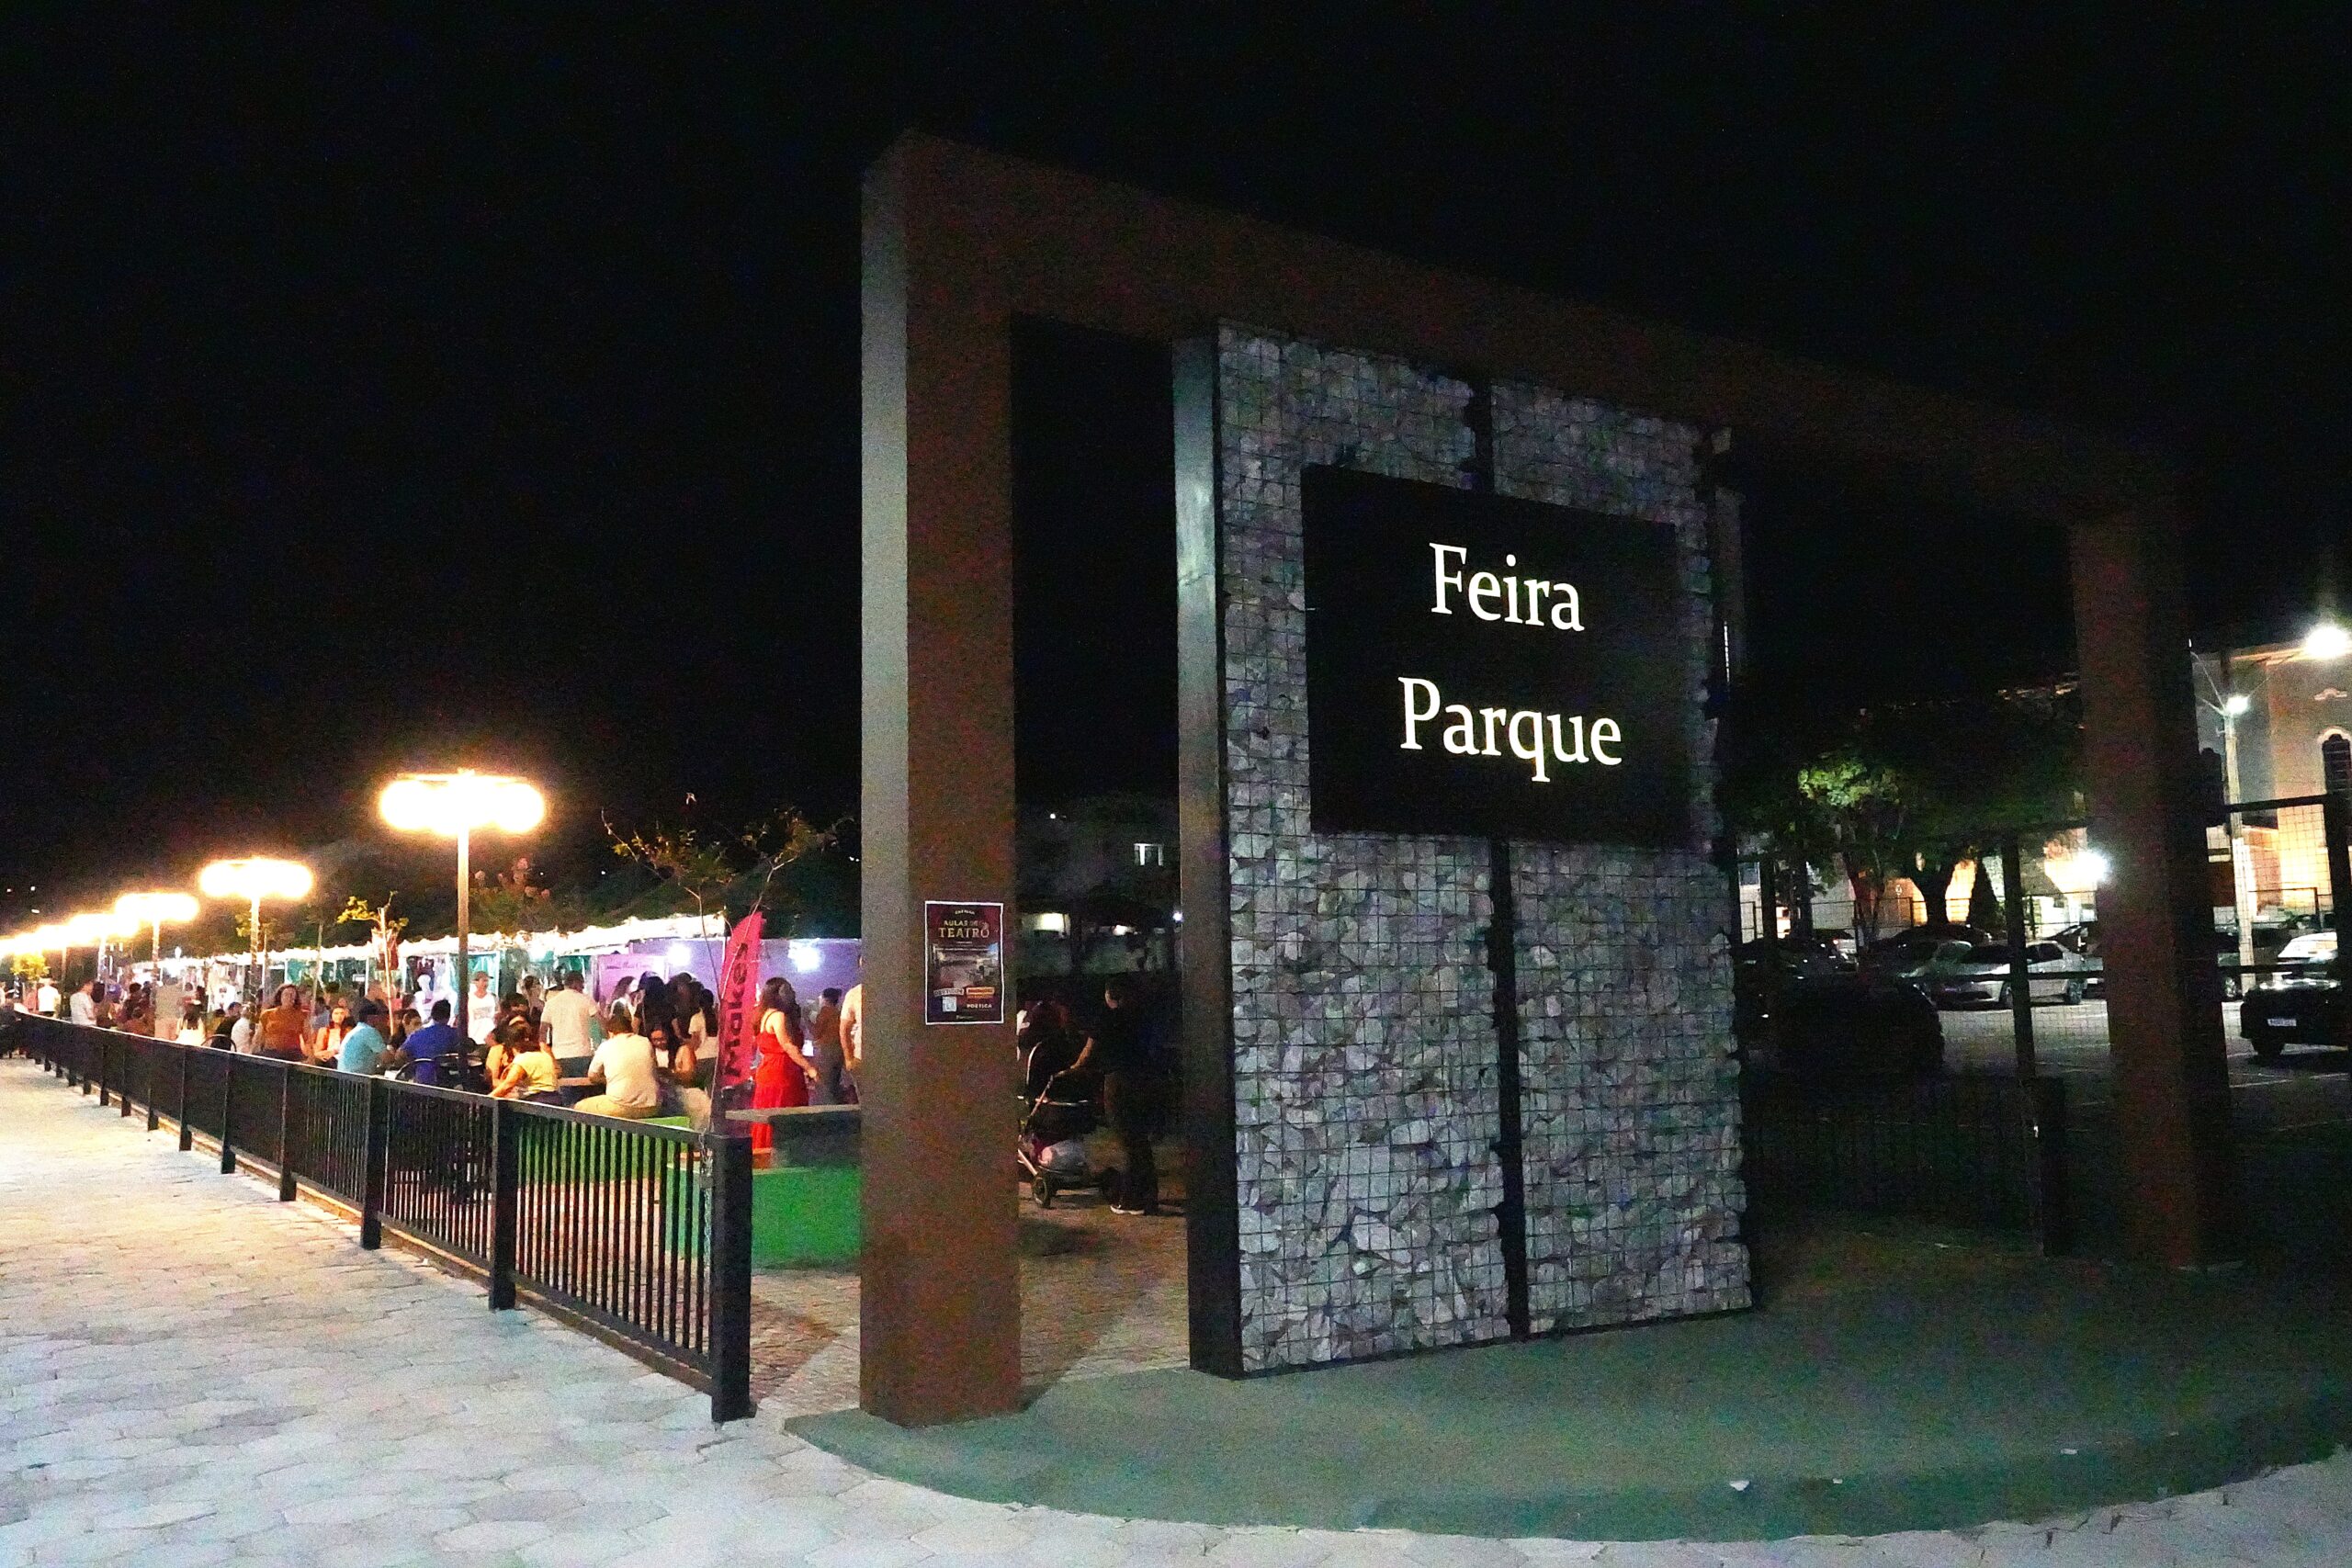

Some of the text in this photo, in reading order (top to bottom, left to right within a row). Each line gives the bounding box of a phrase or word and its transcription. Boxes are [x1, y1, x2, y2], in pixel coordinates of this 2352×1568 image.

[1429, 542, 1585, 632] Feira
[1397, 676, 1623, 783] Parque
[938, 927, 989, 938] TEATRO
[723, 942, 749, 1077] Makes
